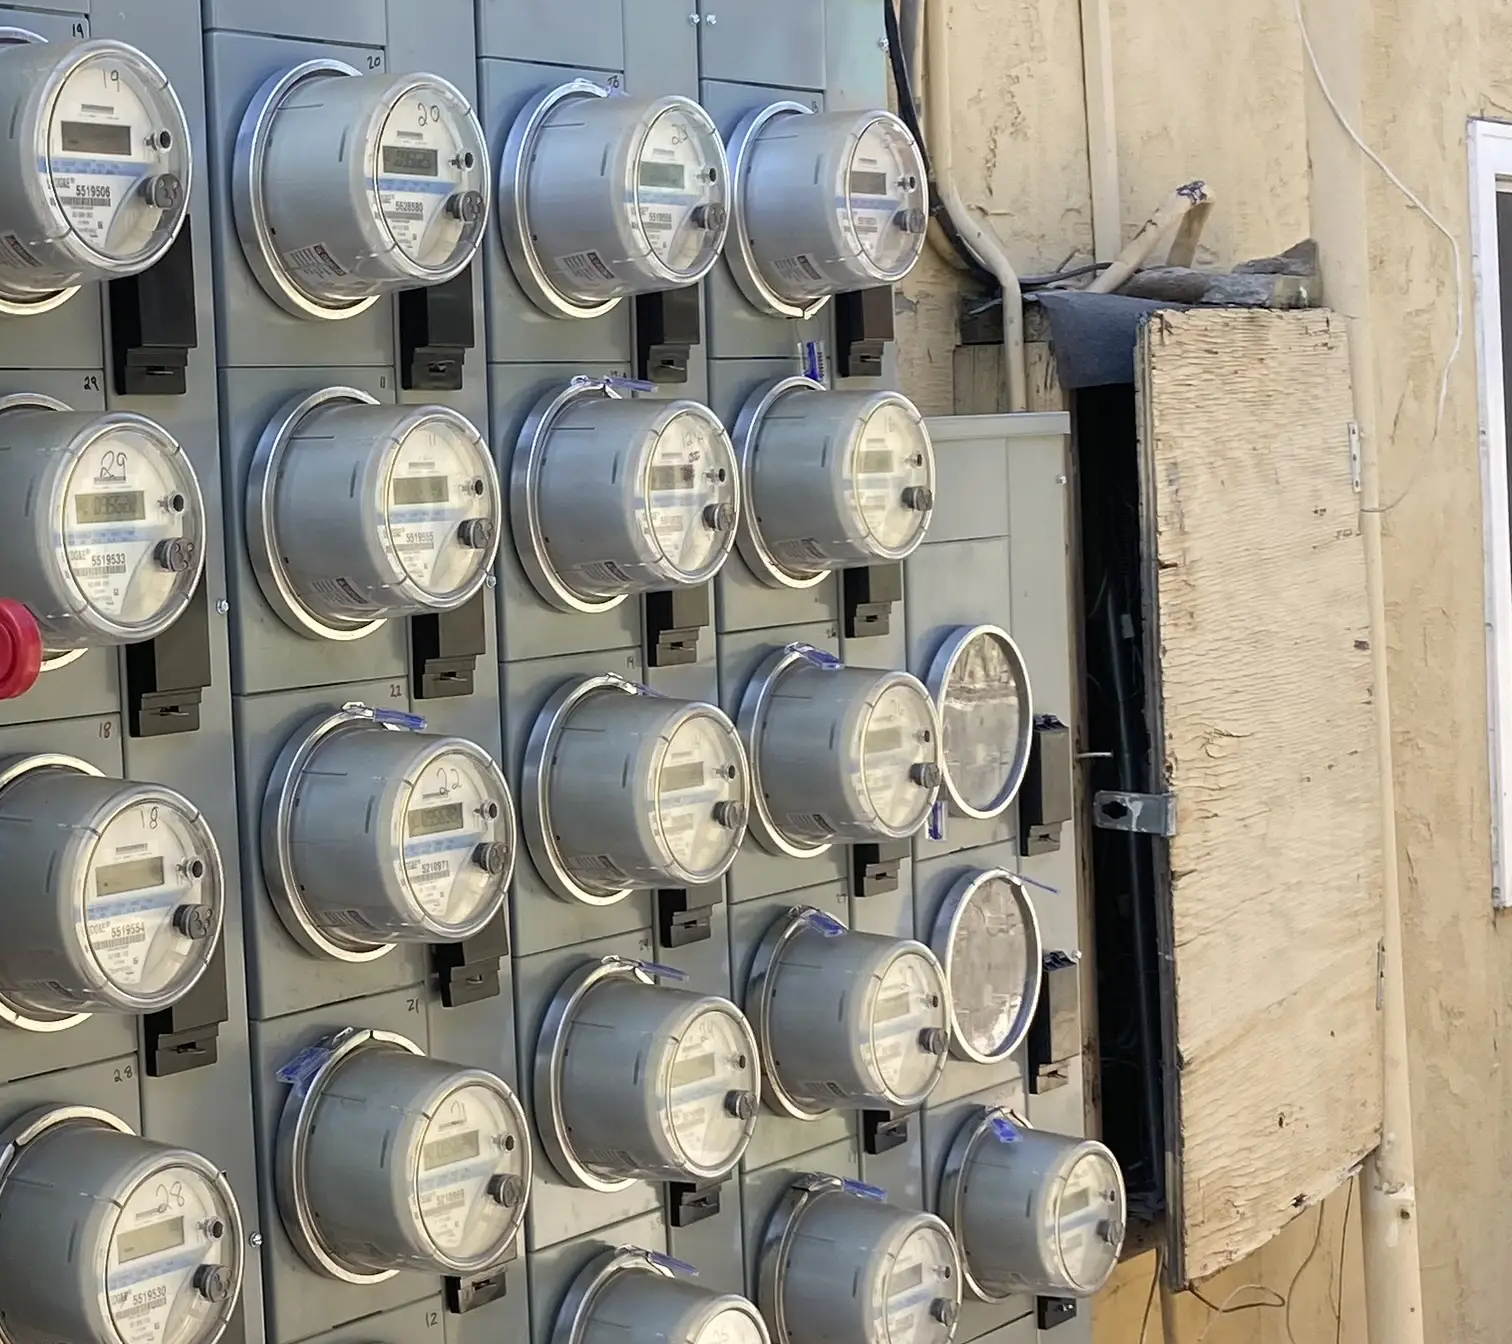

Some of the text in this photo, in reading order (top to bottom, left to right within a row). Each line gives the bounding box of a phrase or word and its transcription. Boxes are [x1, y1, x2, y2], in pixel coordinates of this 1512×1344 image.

[72, 23, 84, 38] 19
[367, 56, 381, 70] 20
[102, 68, 120, 93] 19
[418, 102, 440, 127] 20
[75, 184, 111, 198] 5519506
[84, 376, 100, 391] 29
[100, 450, 128, 481] 29
[91, 553, 126, 567] 5519533
[389, 684, 402, 698] 22
[99, 721, 112, 739] 18
[436, 767, 462, 795] 22
[139, 806, 160, 830] 18
[406, 998, 420, 1014] 21
[113, 1065, 133, 1083] 28
[155, 1180, 186, 1213] 28
[133, 1286, 167, 1305] 5519530
[426, 1312, 438, 1329] 12
